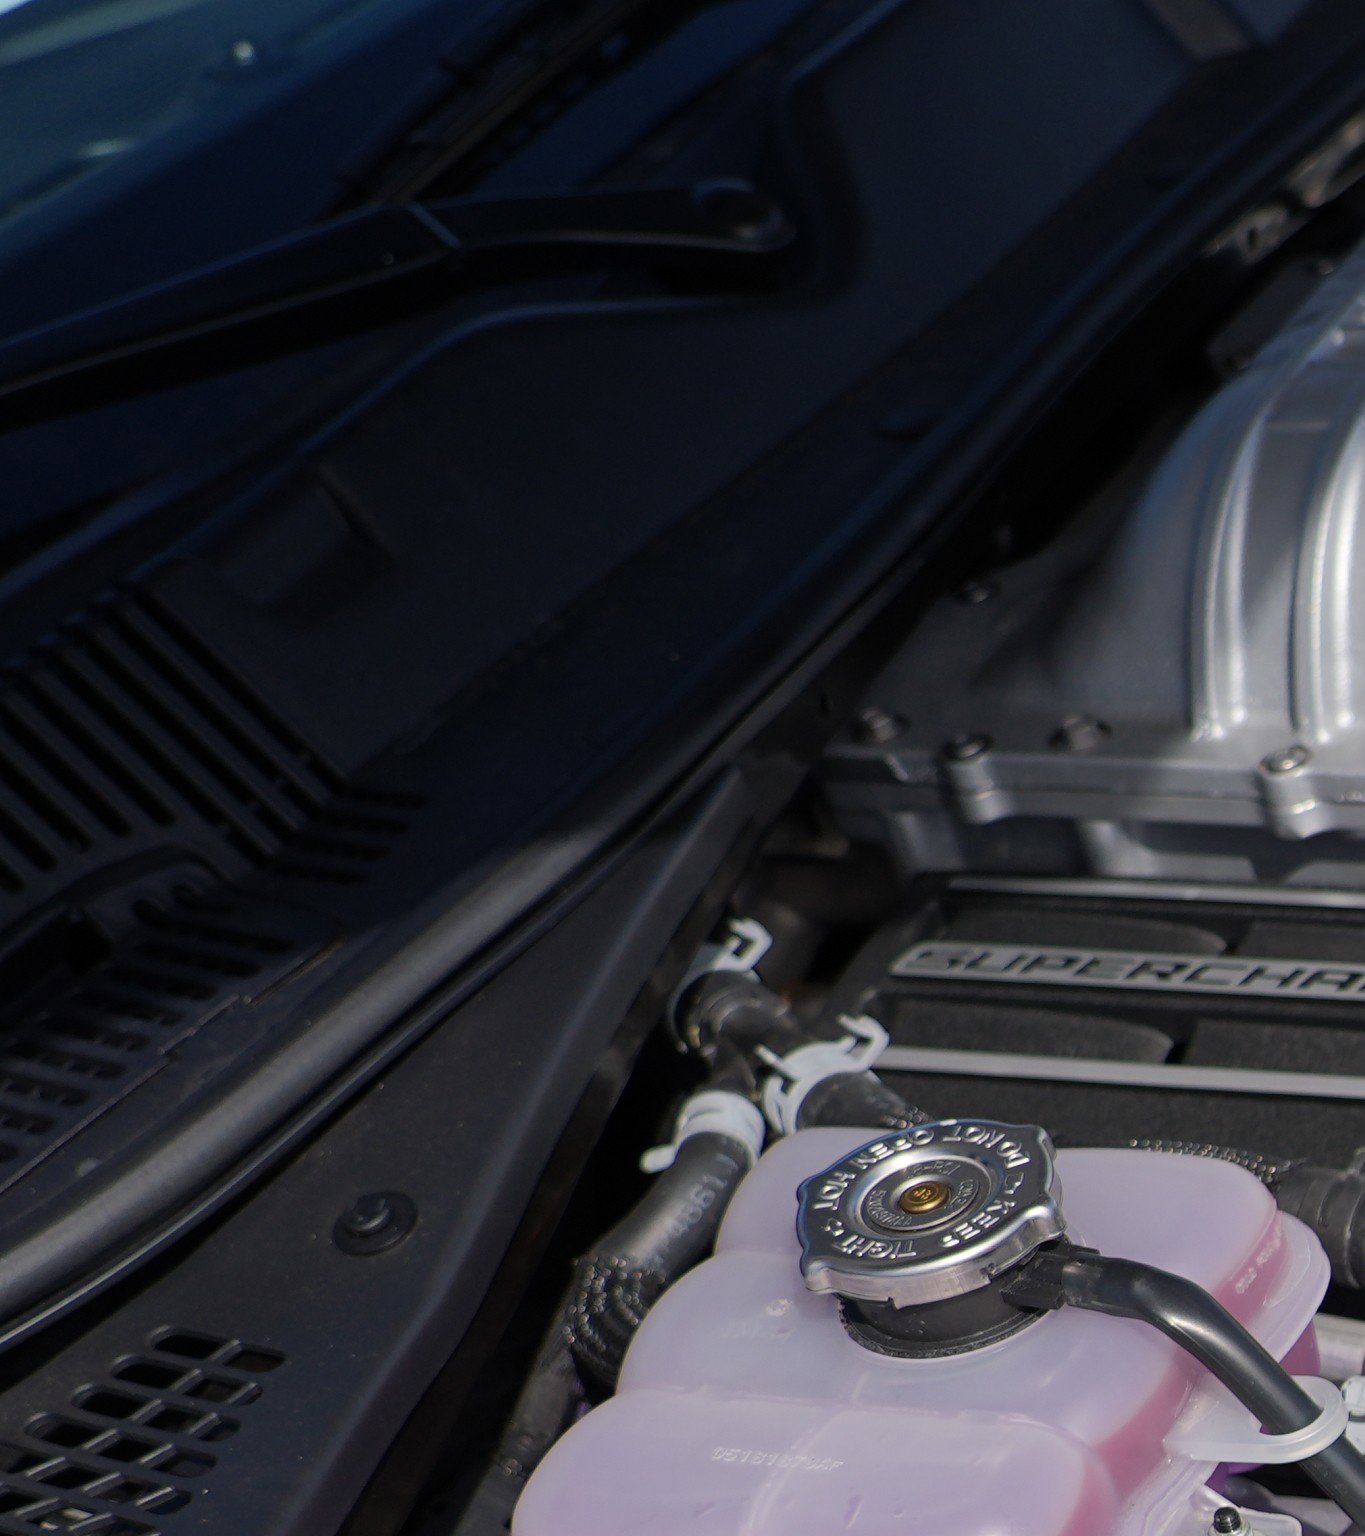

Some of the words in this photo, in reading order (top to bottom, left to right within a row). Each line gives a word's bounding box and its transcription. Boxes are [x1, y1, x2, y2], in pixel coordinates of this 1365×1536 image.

[848, 1128, 935, 1170] OPEN
[941, 1124, 1006, 1150] NOT
[995, 1141, 1031, 1170] DO
[812, 1169, 858, 1212] HOT
[939, 1199, 1017, 1249] KEEP
[832, 1232, 918, 1260] TIGHT
